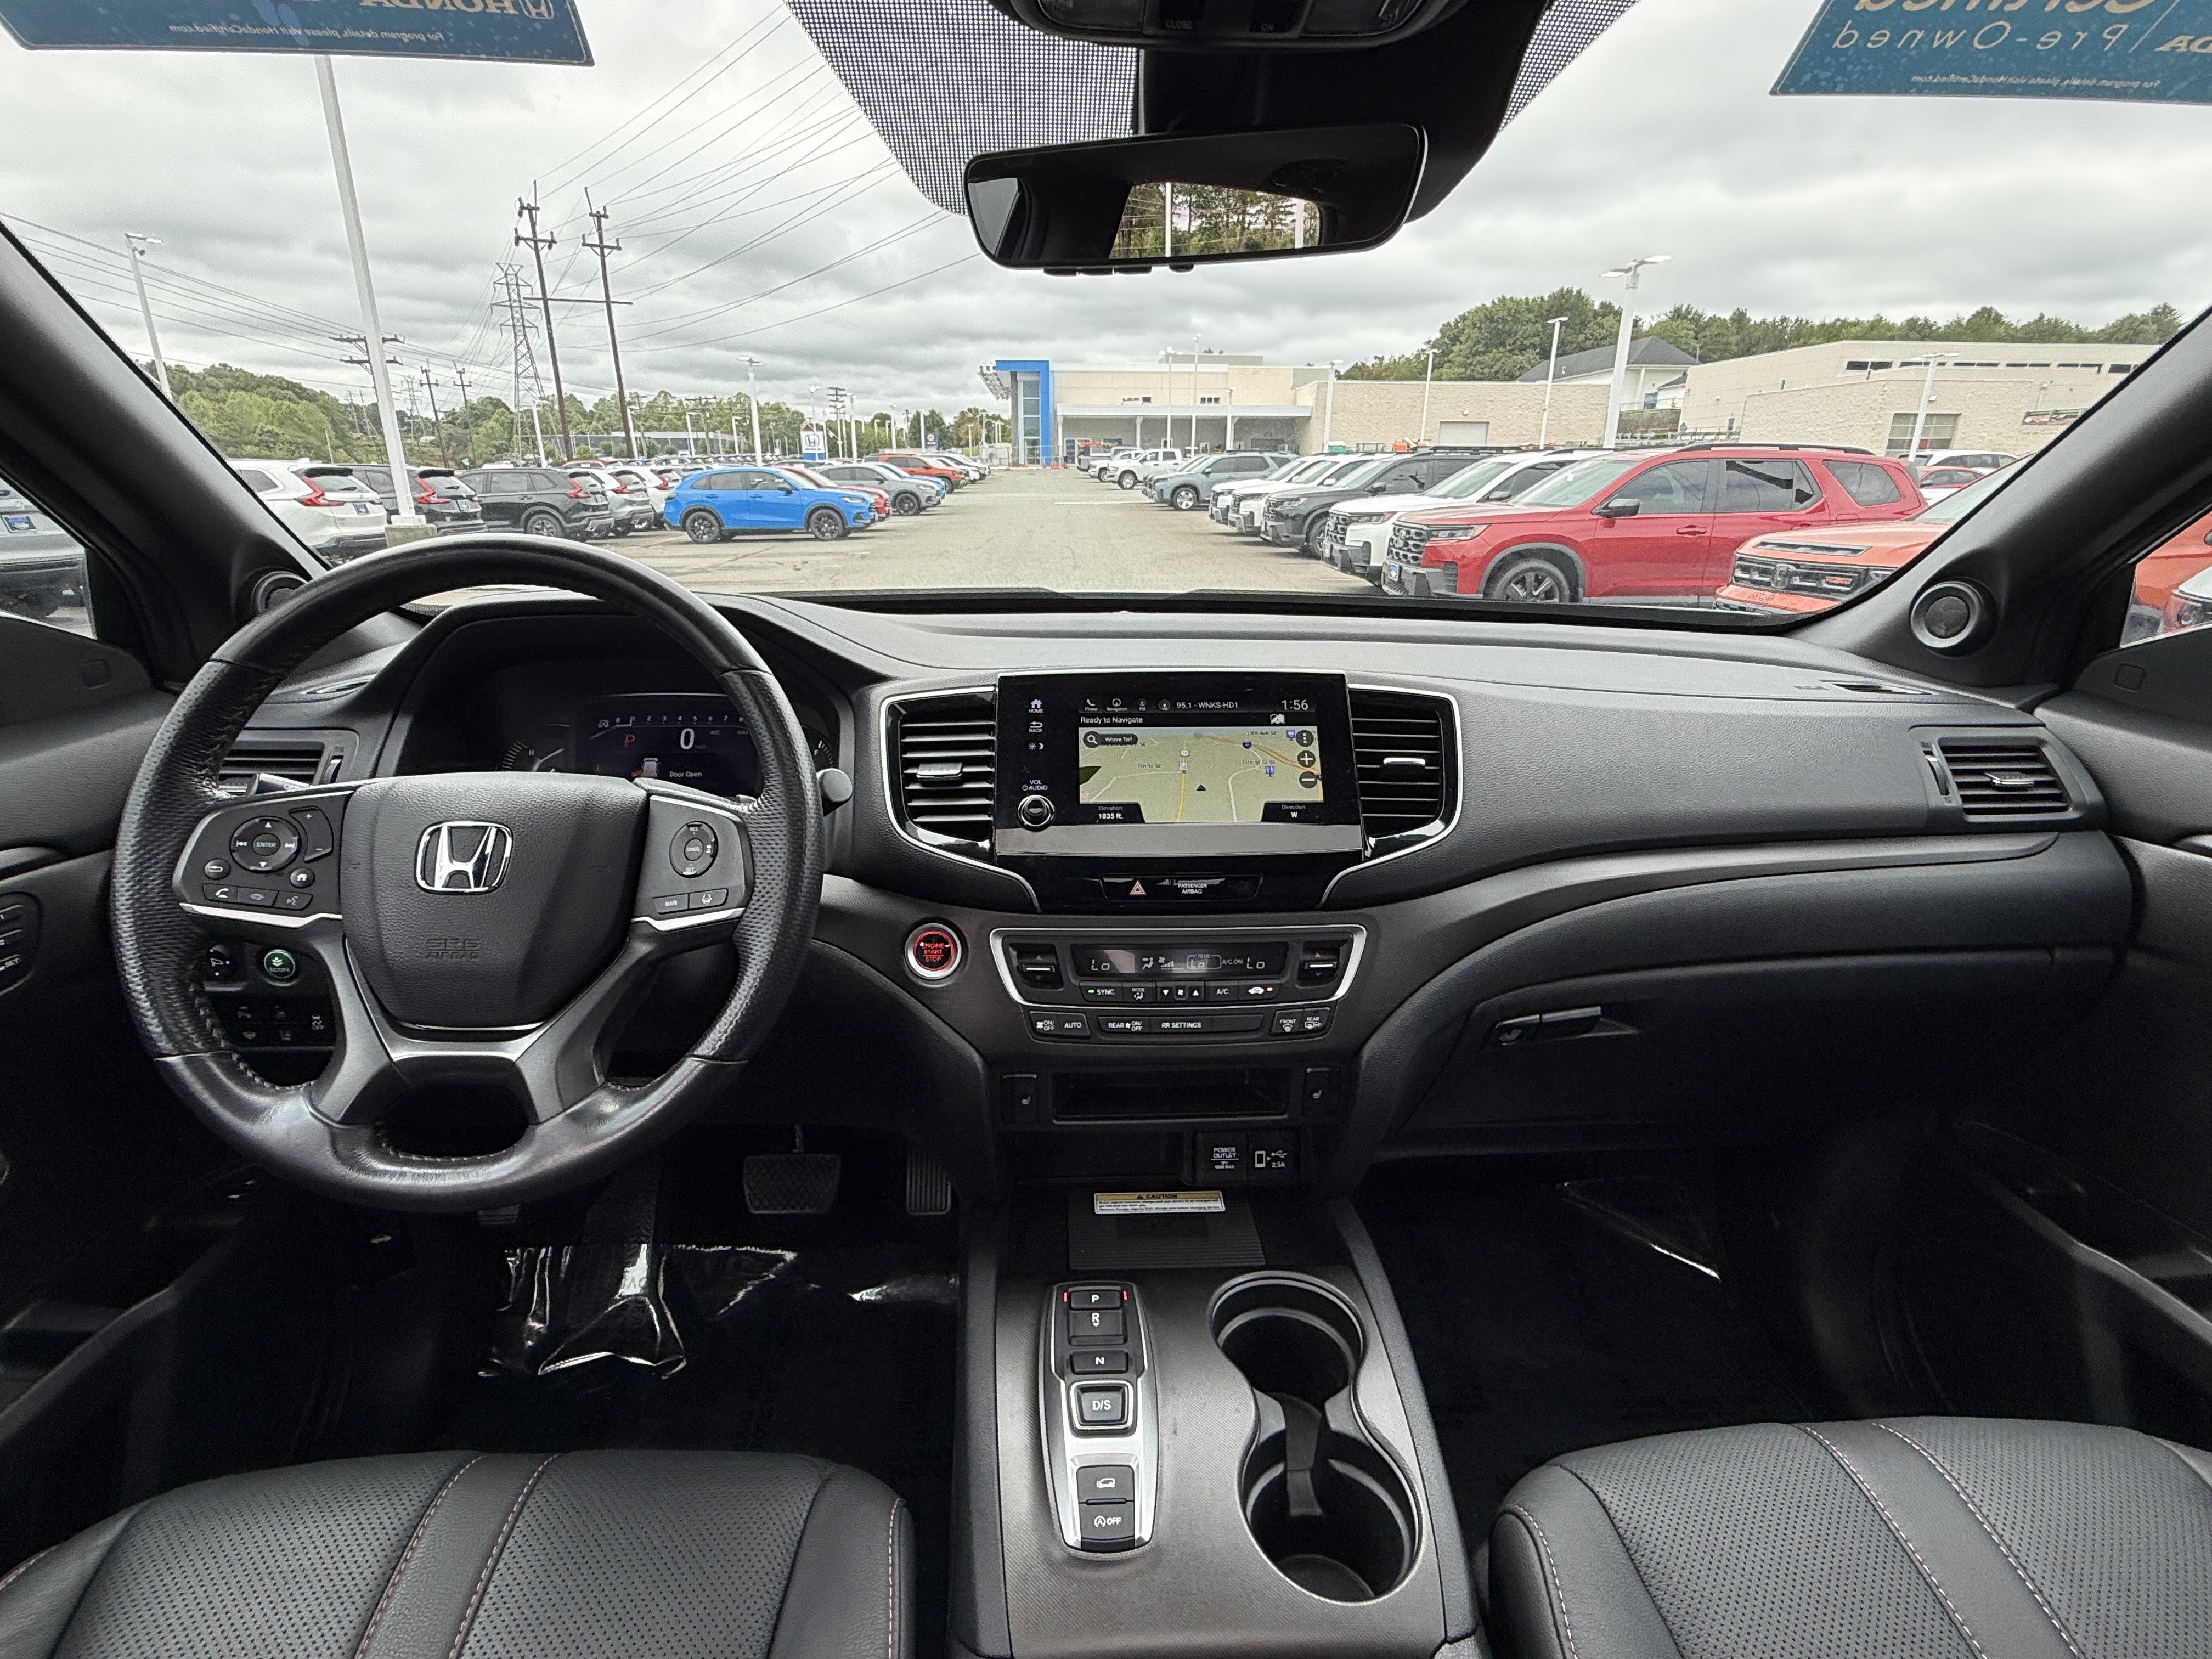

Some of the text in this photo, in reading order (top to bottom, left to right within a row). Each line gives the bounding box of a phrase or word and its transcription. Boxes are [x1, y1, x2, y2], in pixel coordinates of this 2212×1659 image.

[1281, 699, 1309, 710] 1:56
[680, 727, 695, 750] 0
[1091, 958, 1111, 971] Lo
[1246, 957, 1266, 969] Lo
[1091, 1295, 1099, 1303] P
[1091, 1312, 1100, 1323] R
[1095, 1357, 1105, 1365] N
[1092, 1400, 1111, 1410] D/S
[1106, 1517, 1122, 1526] OFF
